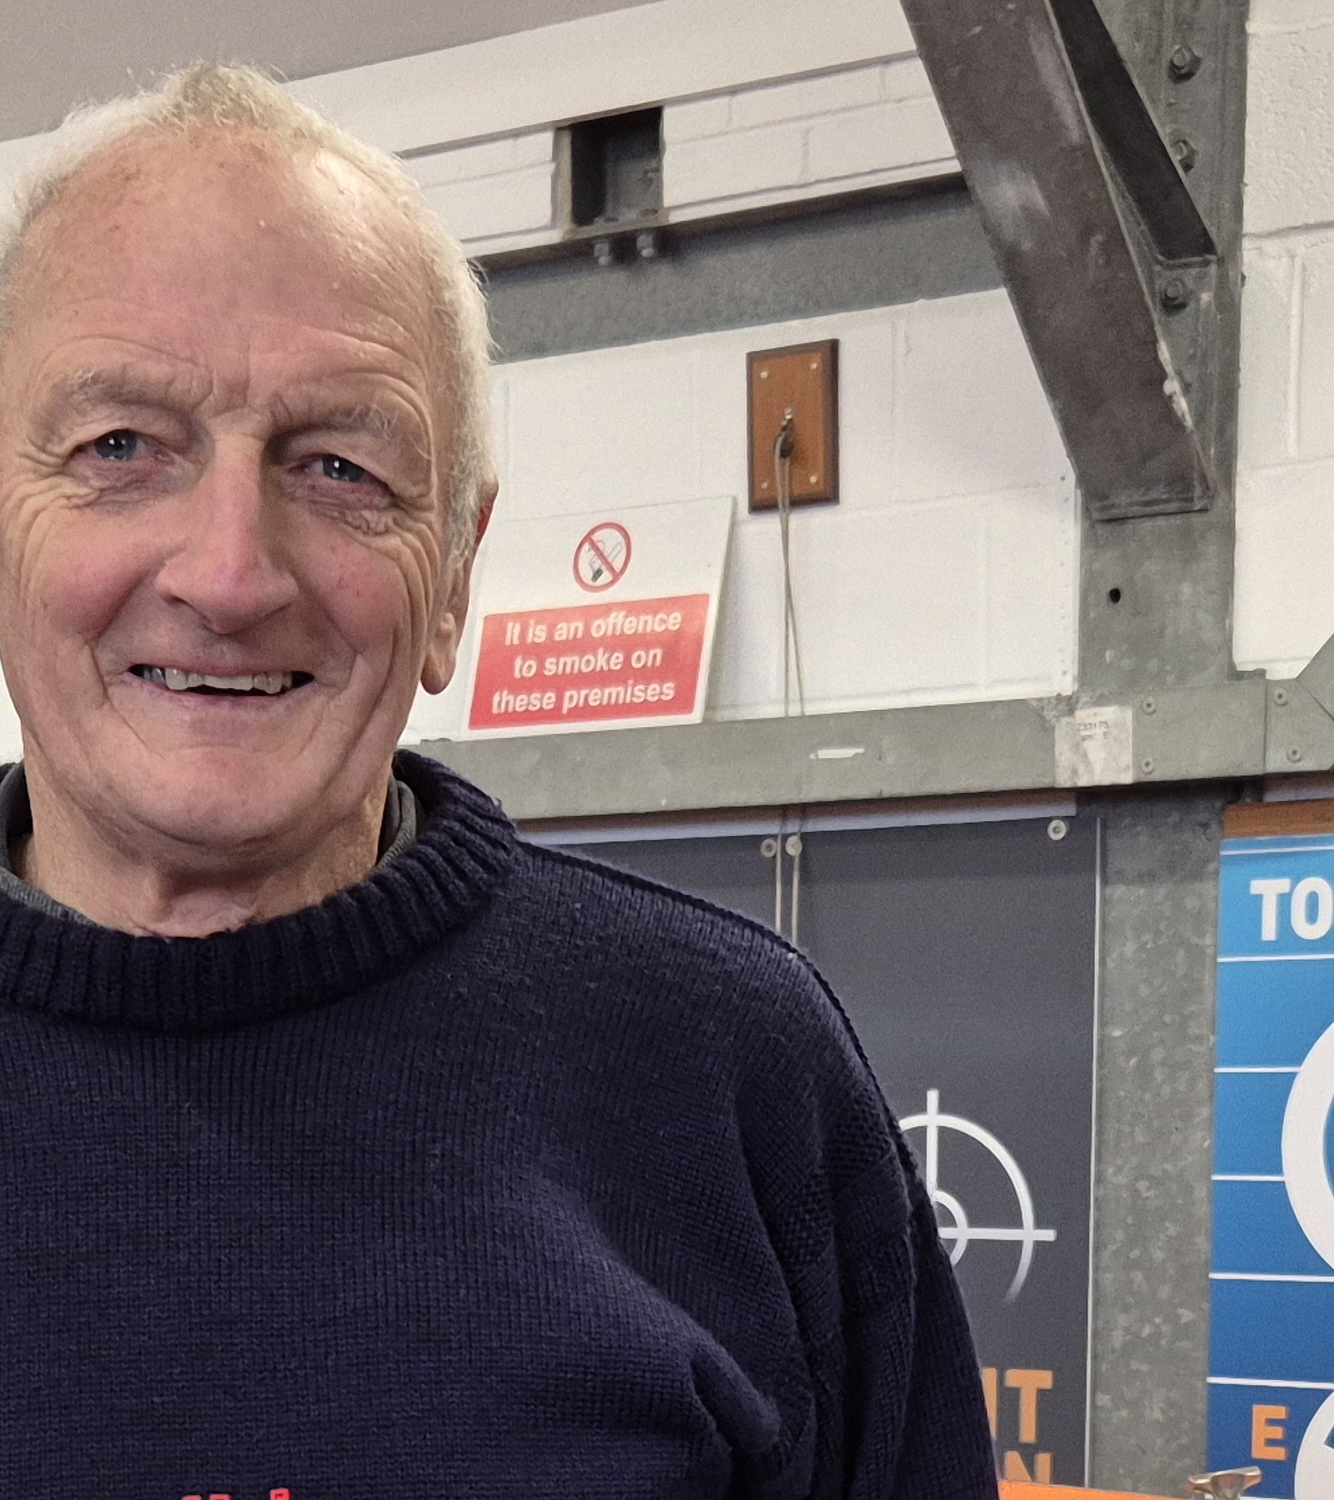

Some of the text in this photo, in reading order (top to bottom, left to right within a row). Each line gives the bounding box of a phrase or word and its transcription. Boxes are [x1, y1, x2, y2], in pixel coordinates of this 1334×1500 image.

[504, 608, 683, 646] It is an offence
[513, 647, 663, 679] to smoke on
[492, 679, 676, 715] these premises
[1250, 1404, 1289, 1461] E
